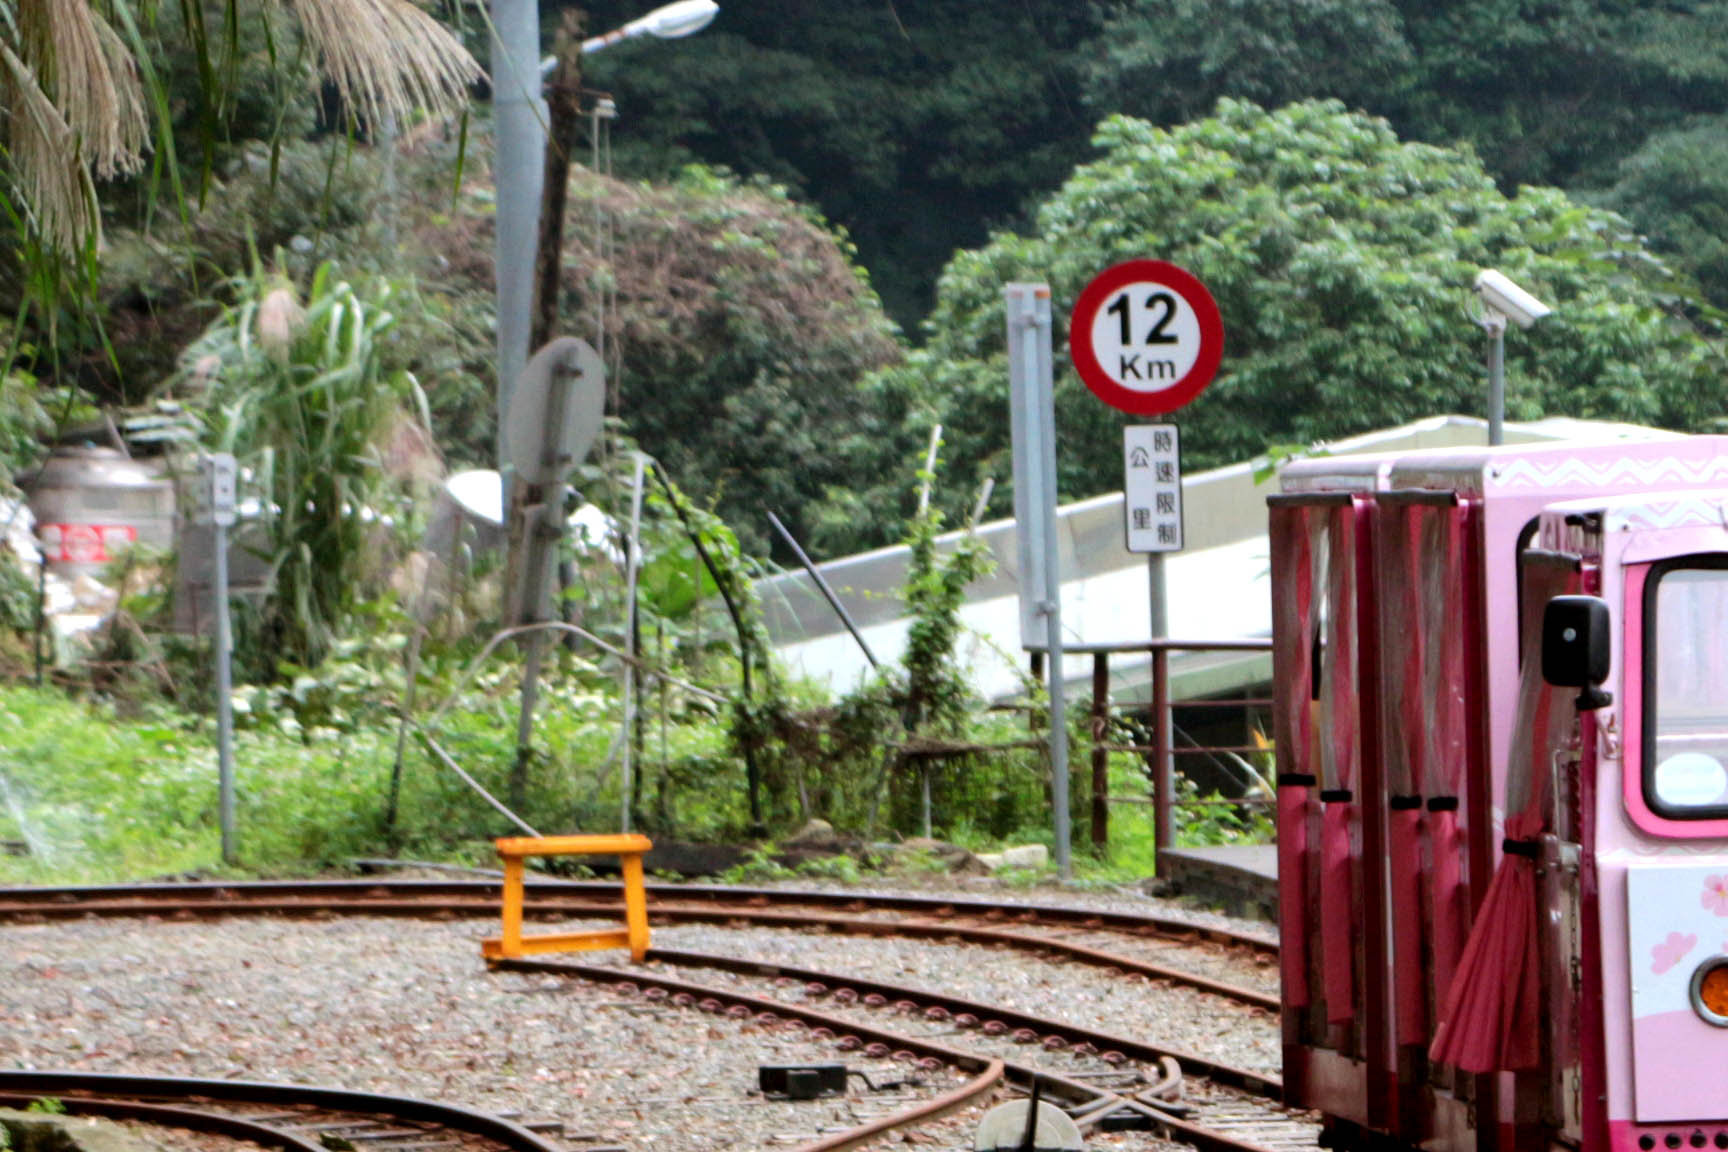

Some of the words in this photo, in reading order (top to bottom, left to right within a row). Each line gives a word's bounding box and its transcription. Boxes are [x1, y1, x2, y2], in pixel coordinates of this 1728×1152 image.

[1107, 292, 1179, 346] 12
[1120, 354, 1176, 380] Km
[1130, 445, 1152, 530] 公里
[1153, 430, 1178, 545] 時速限制
